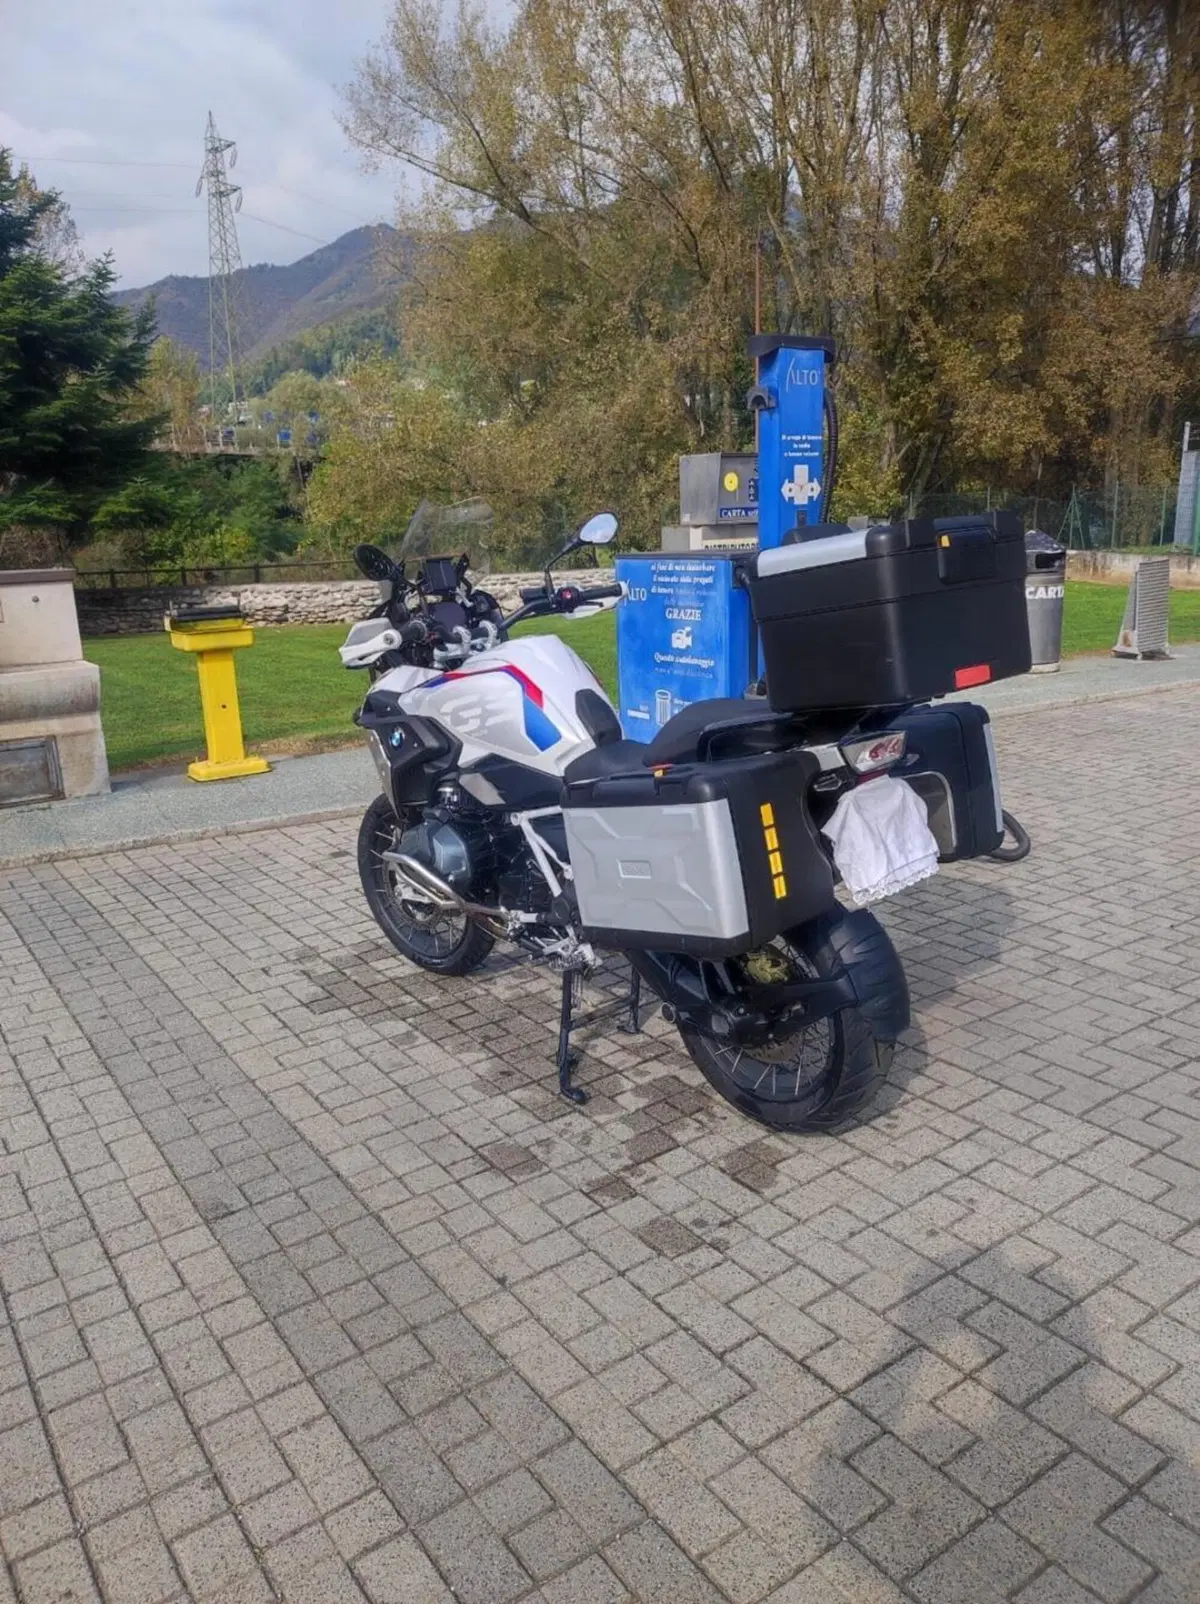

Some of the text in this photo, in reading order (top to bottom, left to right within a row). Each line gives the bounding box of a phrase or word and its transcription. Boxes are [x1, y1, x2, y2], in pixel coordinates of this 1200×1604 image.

[785, 357, 819, 394] ALTO
[721, 508, 746, 518] CARTA
[665, 608, 702, 622] GRAZIE
